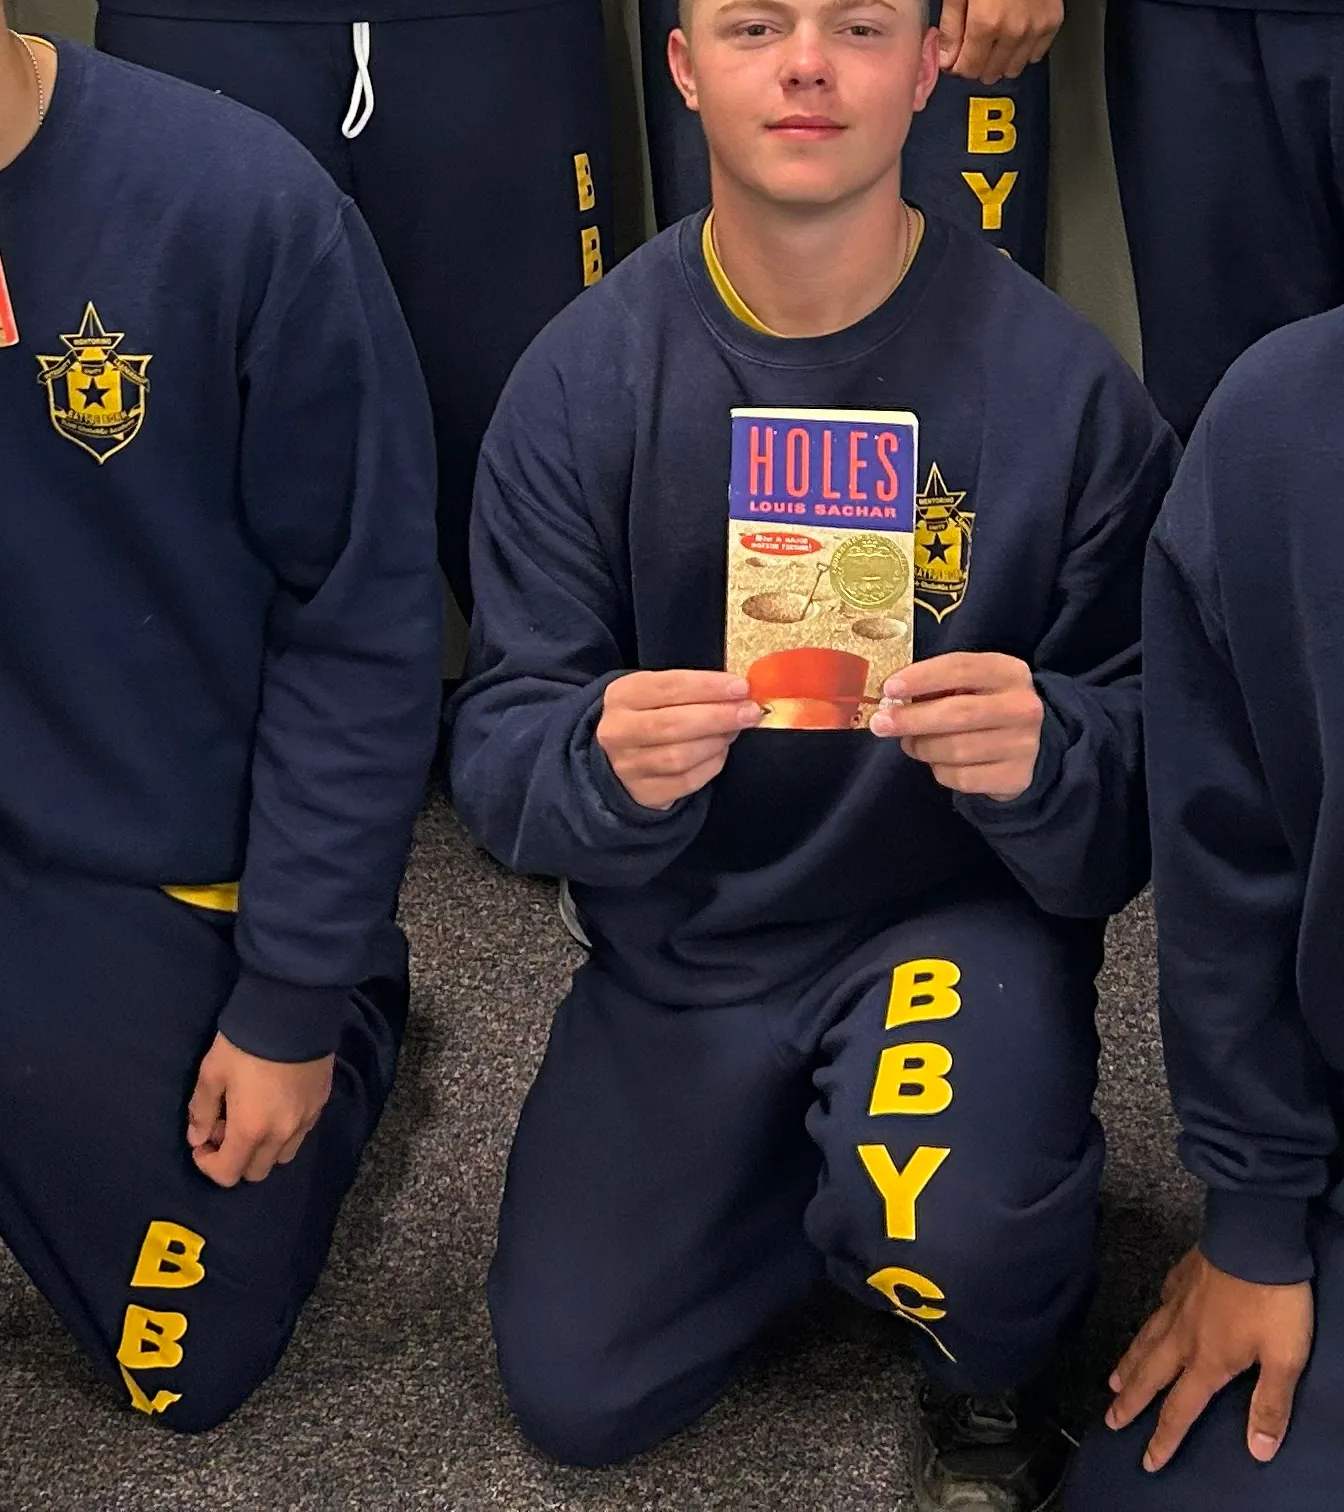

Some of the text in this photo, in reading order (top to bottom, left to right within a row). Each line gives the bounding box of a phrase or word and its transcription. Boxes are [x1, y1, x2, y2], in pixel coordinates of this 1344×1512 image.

[749, 426, 900, 502] HOLES
[749, 500, 898, 519] LOUIS SACHAR
